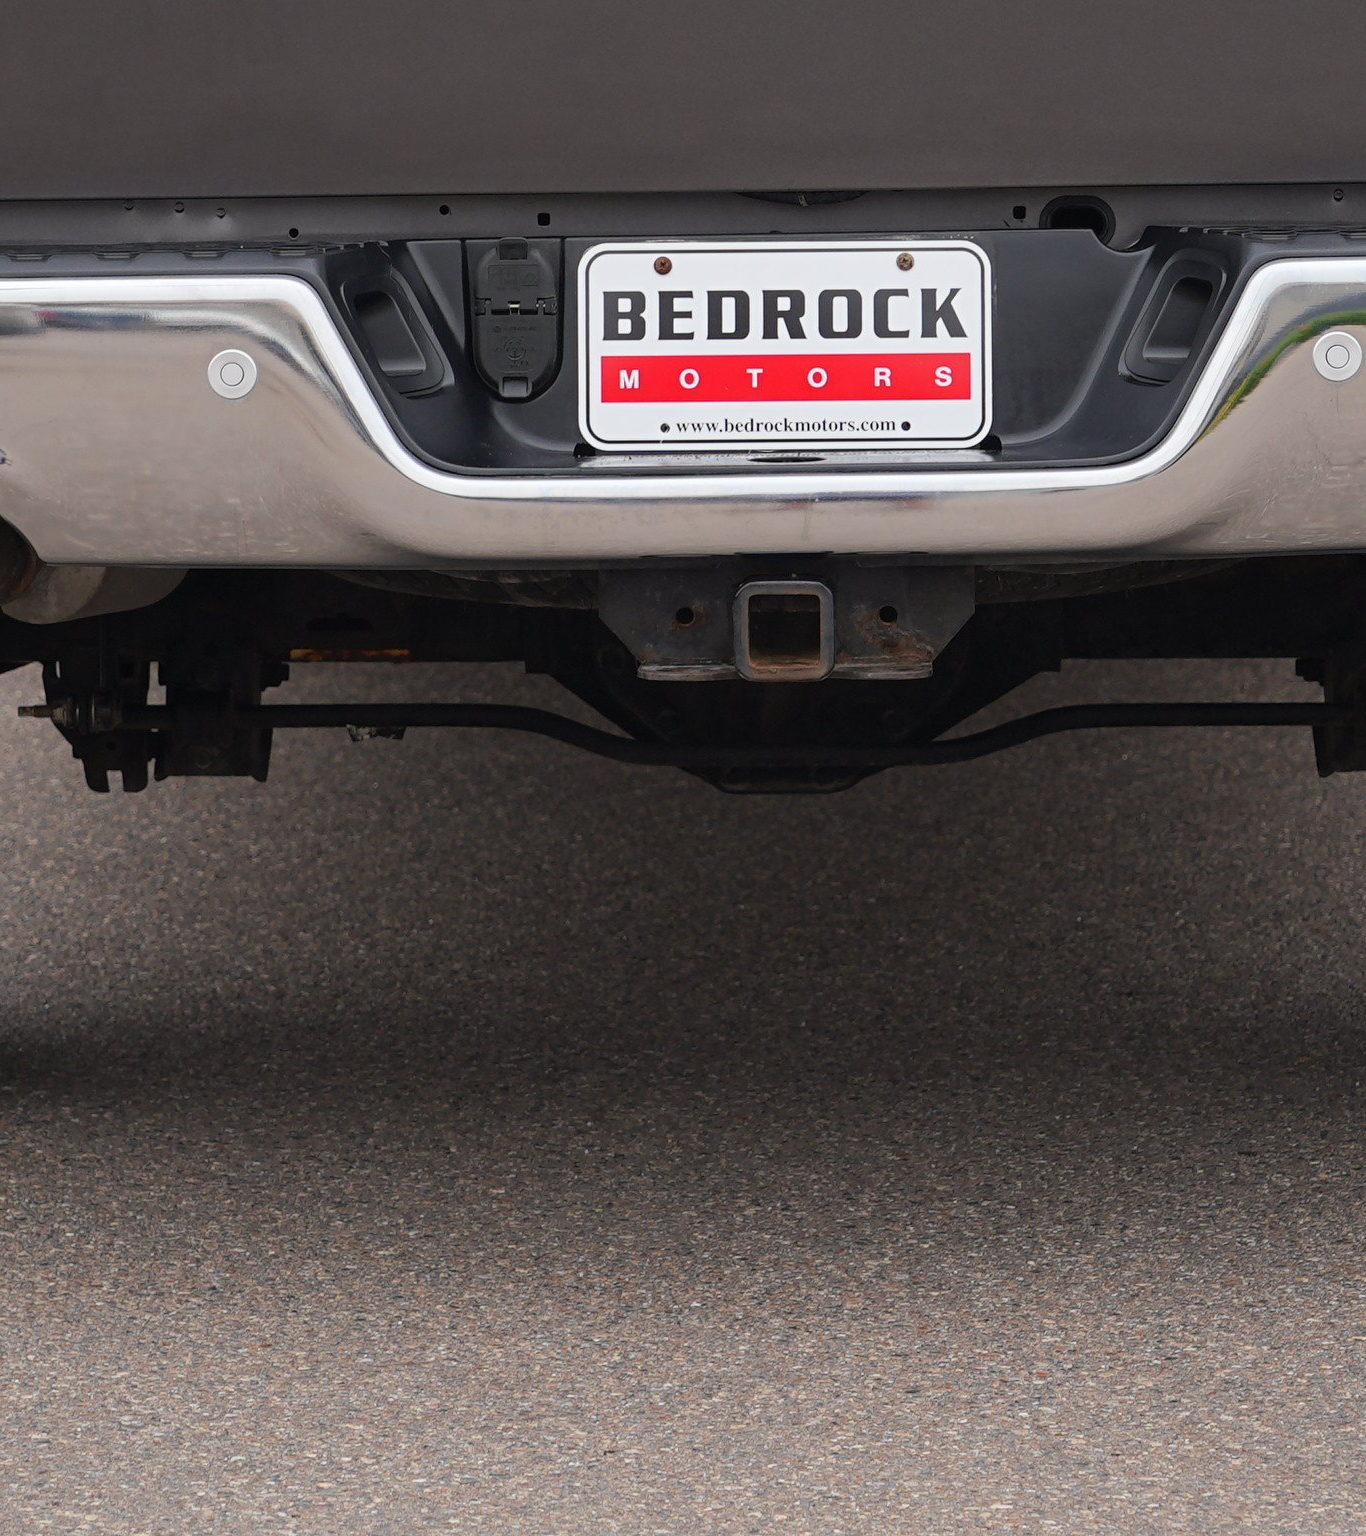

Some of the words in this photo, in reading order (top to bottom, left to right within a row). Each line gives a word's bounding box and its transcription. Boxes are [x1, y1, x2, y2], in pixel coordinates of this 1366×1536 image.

[602, 288, 968, 341] BEDROCK
[618, 366, 954, 389] MOTORS
[676, 417, 897, 434] www.bedrockmotors.com
